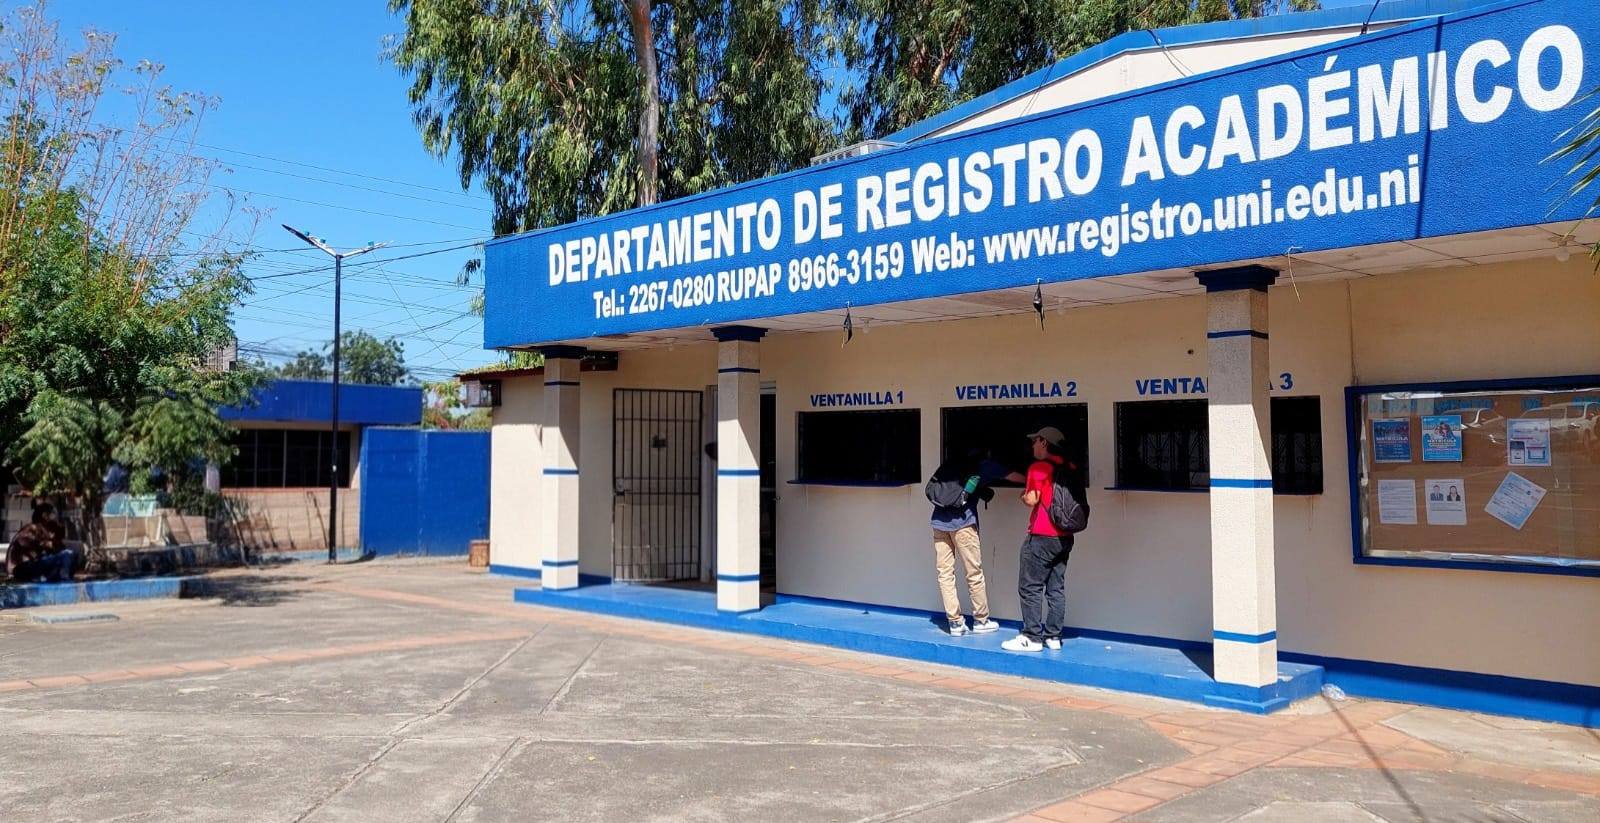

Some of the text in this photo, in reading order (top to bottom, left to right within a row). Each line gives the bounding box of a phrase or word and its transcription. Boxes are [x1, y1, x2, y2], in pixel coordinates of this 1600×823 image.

[548, 24, 1584, 286] DEPARTAMENTO DE REGISTRO ACADÉMICO
[592, 153, 1422, 320] Tel.: 2267-0280 RUPAP 8966-3159 Web: www.registro.uni.edu.ni
[955, 380, 1078, 401] VENTANILLA 2
[1279, 372, 1294, 391] 3
[810, 390, 904, 407] VENTANILLA 1
